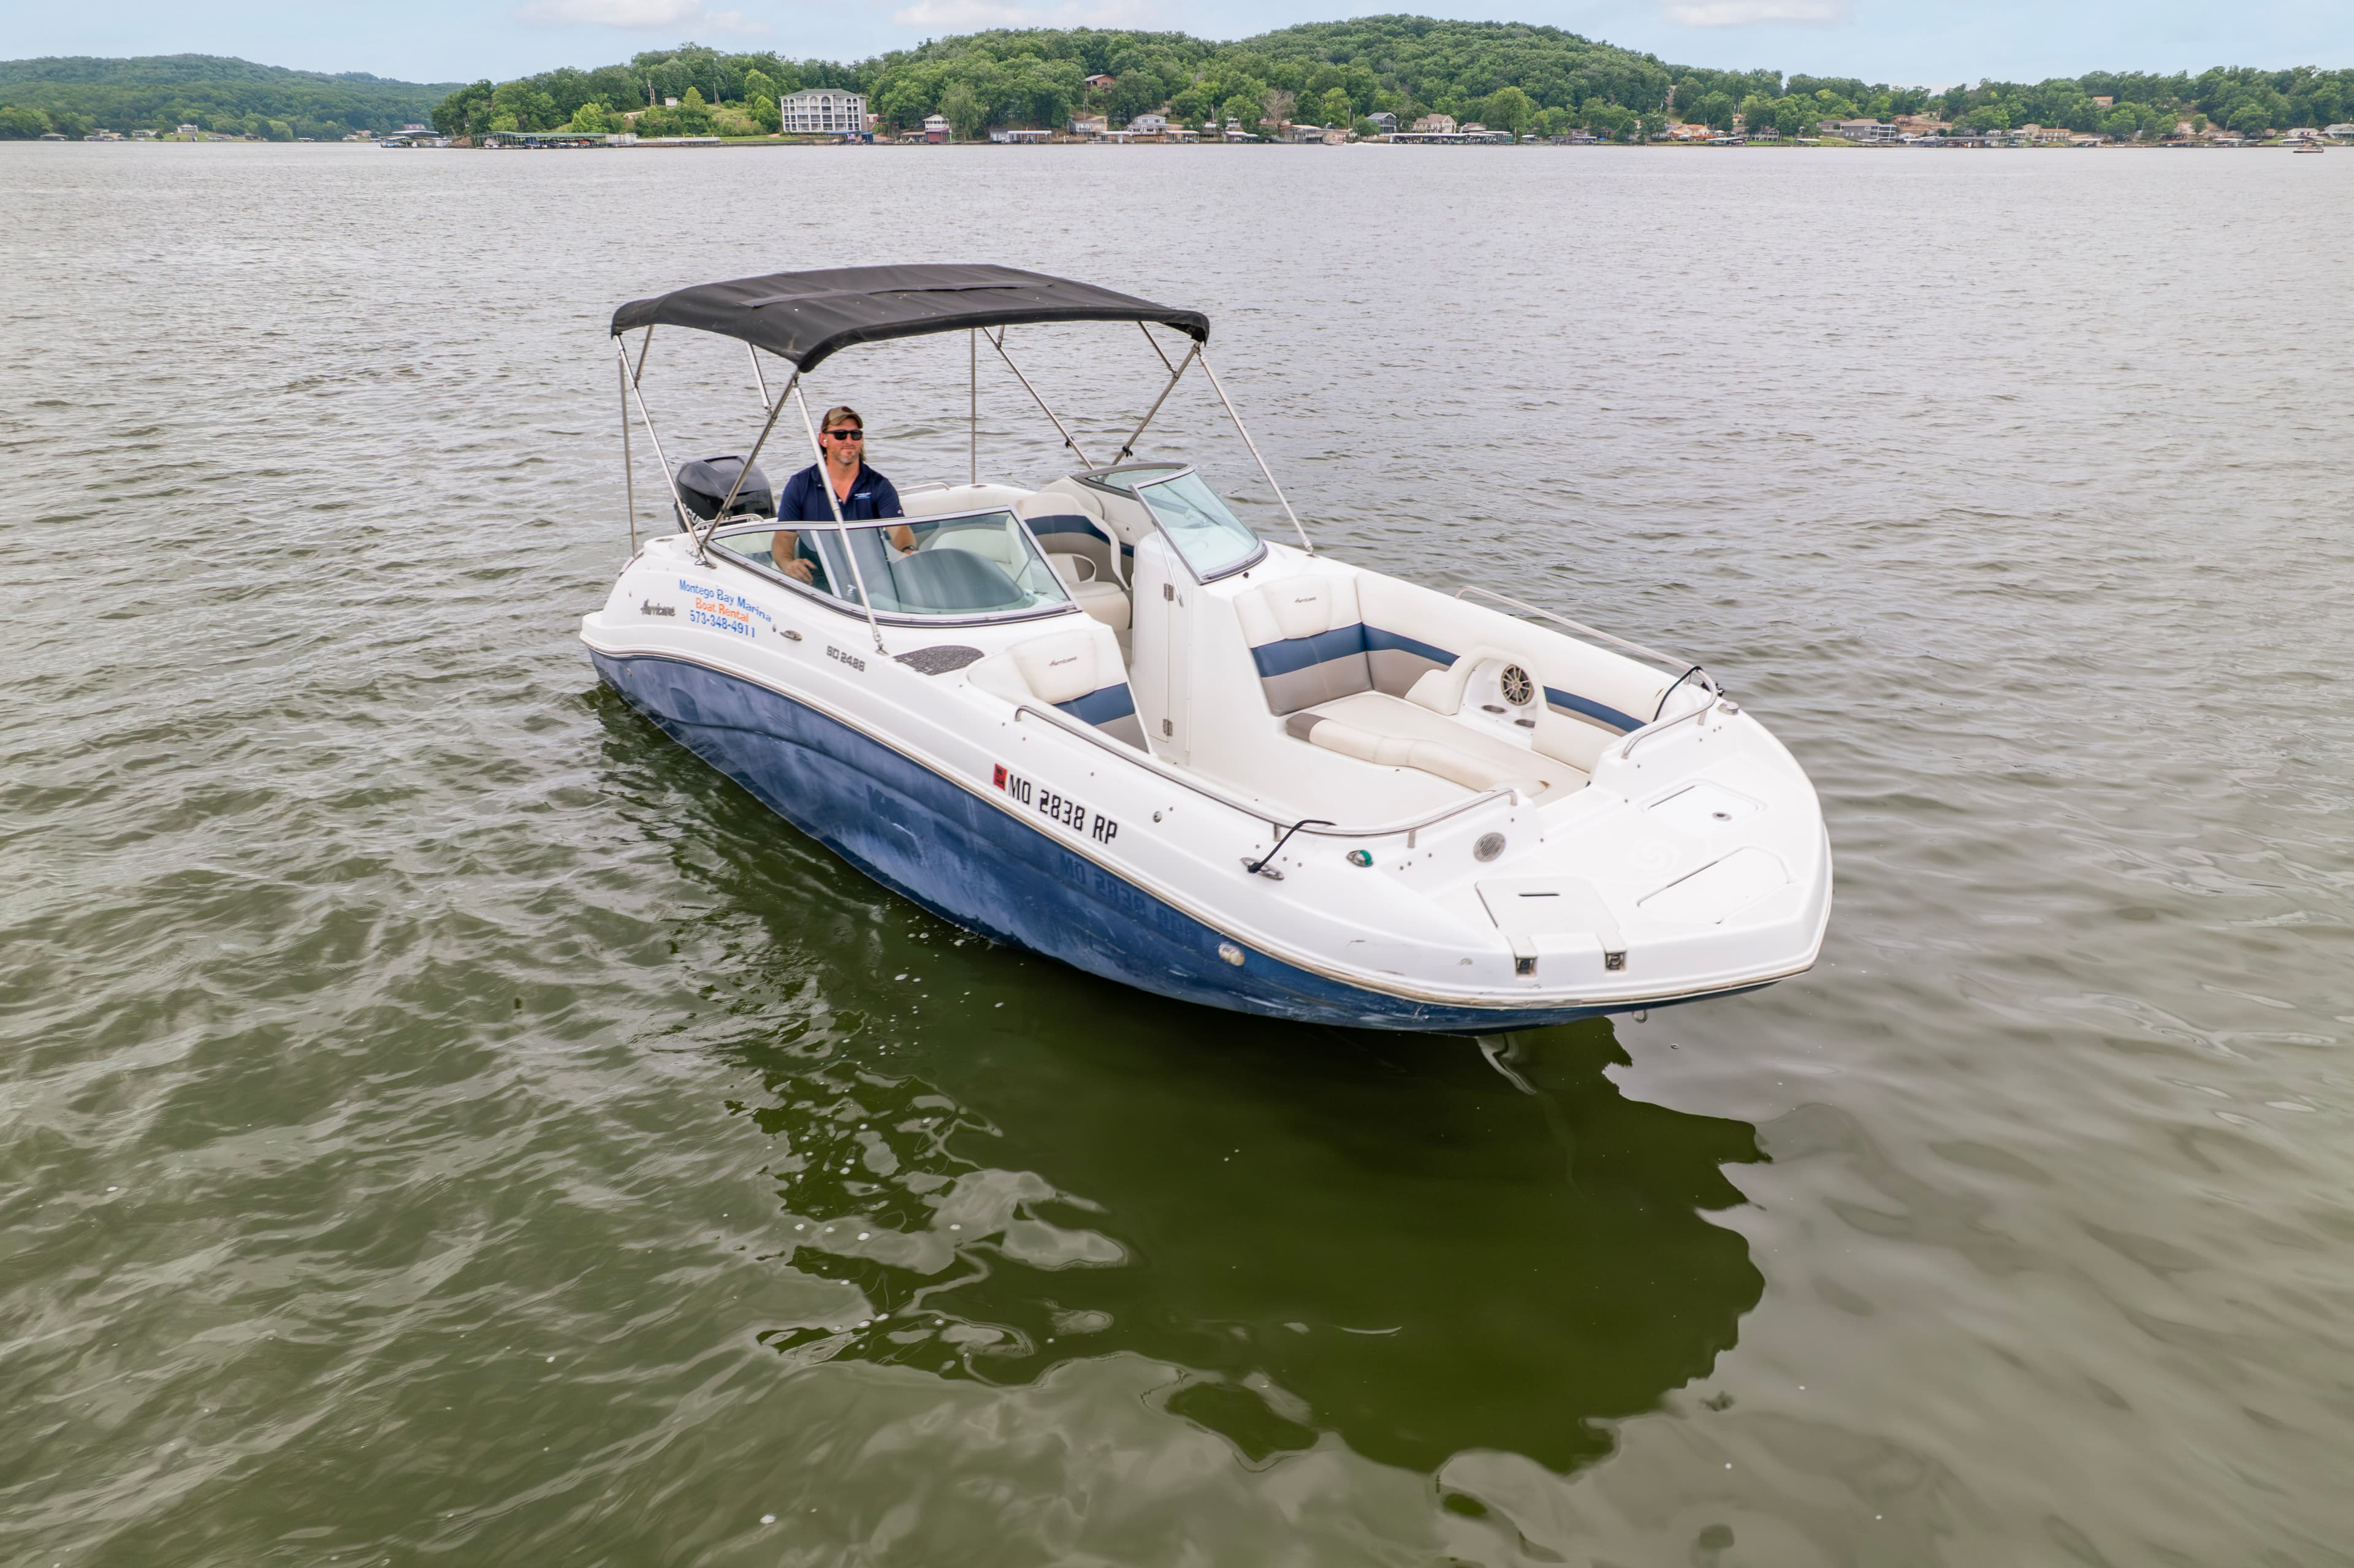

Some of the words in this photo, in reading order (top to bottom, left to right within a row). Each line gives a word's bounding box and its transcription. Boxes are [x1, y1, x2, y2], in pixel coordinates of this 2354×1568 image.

[679, 579, 714, 599] Montego
[717, 589, 734, 606] Bay
[737, 596, 772, 622] Marina
[696, 598, 716, 612] Boat
[718, 604, 749, 623] Rental
[690, 609, 755, 638] 573-348-4911
[1009, 774, 1031, 805] MO
[1040, 789, 1085, 831] 2838
[1092, 813, 1118, 845] RP
